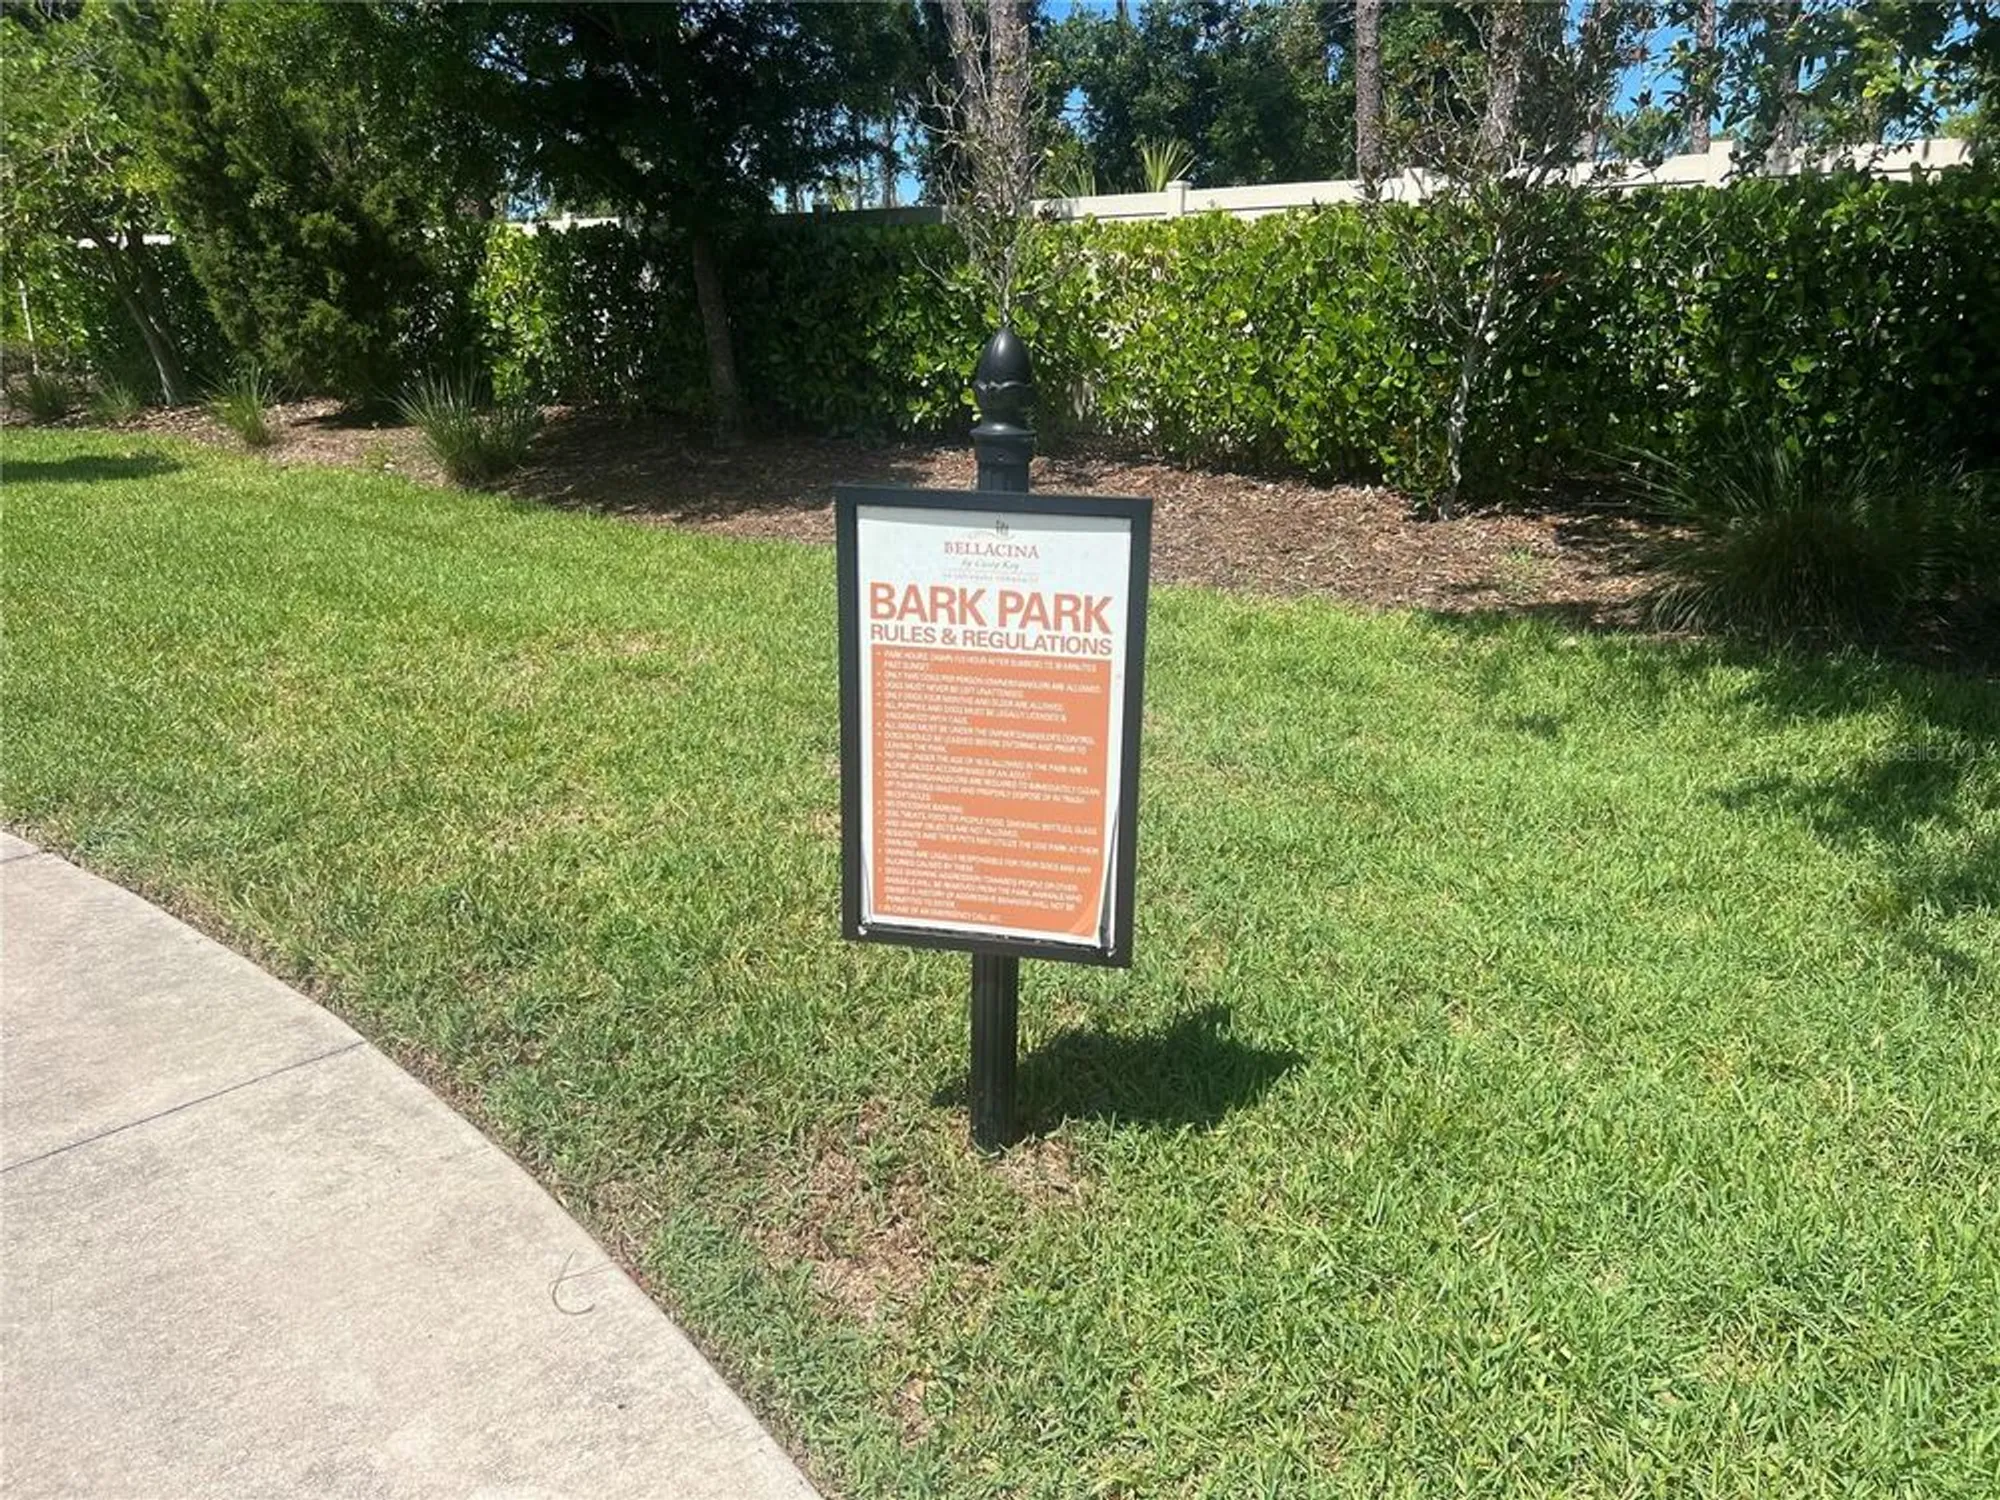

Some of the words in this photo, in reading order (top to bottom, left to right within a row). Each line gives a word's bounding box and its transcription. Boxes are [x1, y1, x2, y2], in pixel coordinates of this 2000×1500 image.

[944, 541, 1040, 560] BELLACINA
[870, 582, 987, 627] BARK
[998, 590, 1113, 634] PARK
[871, 624, 936, 643] RULES
[941, 628, 957, 645] &
[962, 629, 1113, 655] REGULATIONS
